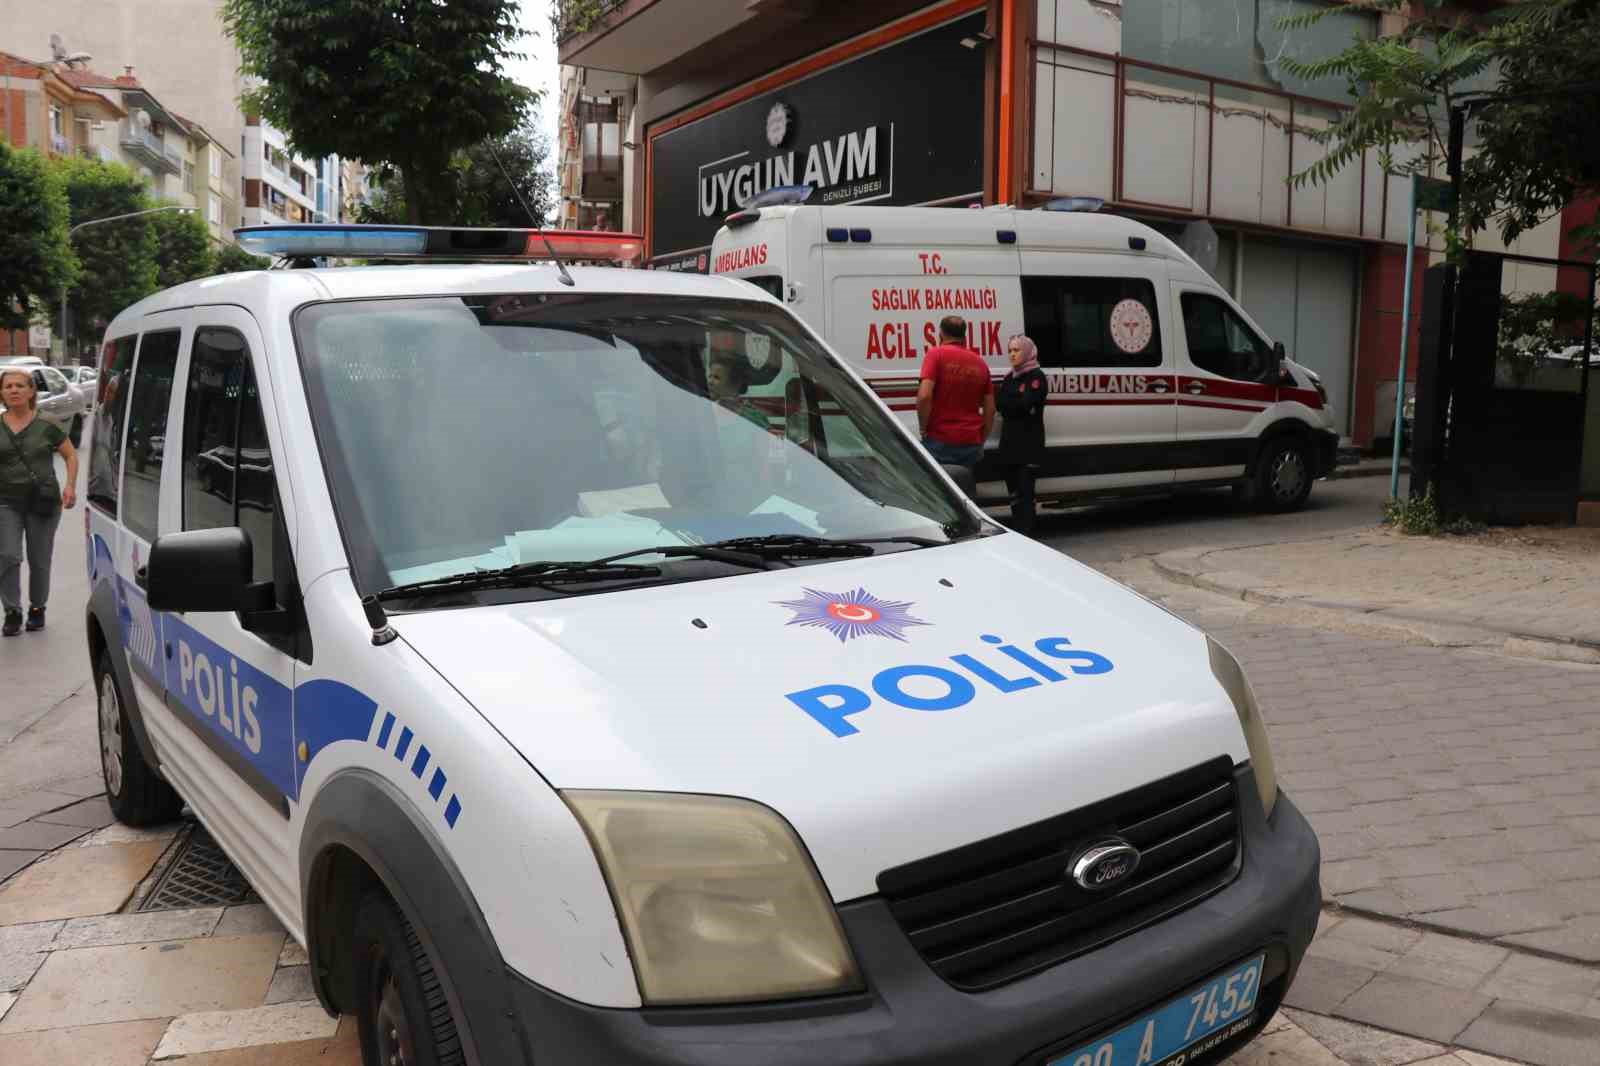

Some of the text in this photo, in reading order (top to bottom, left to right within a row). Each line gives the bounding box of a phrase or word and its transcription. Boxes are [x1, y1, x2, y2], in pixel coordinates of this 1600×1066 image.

[701, 125, 877, 217] UYGUN AVM
[918, 253, 947, 275] T.C.
[867, 321, 1003, 360] ACİL SLIK
[1047, 374, 1148, 394] MBULANS
[178, 638, 262, 754] POLİS
[784, 634, 1114, 738] POLİS
[1184, 965, 1258, 1042] 7452
